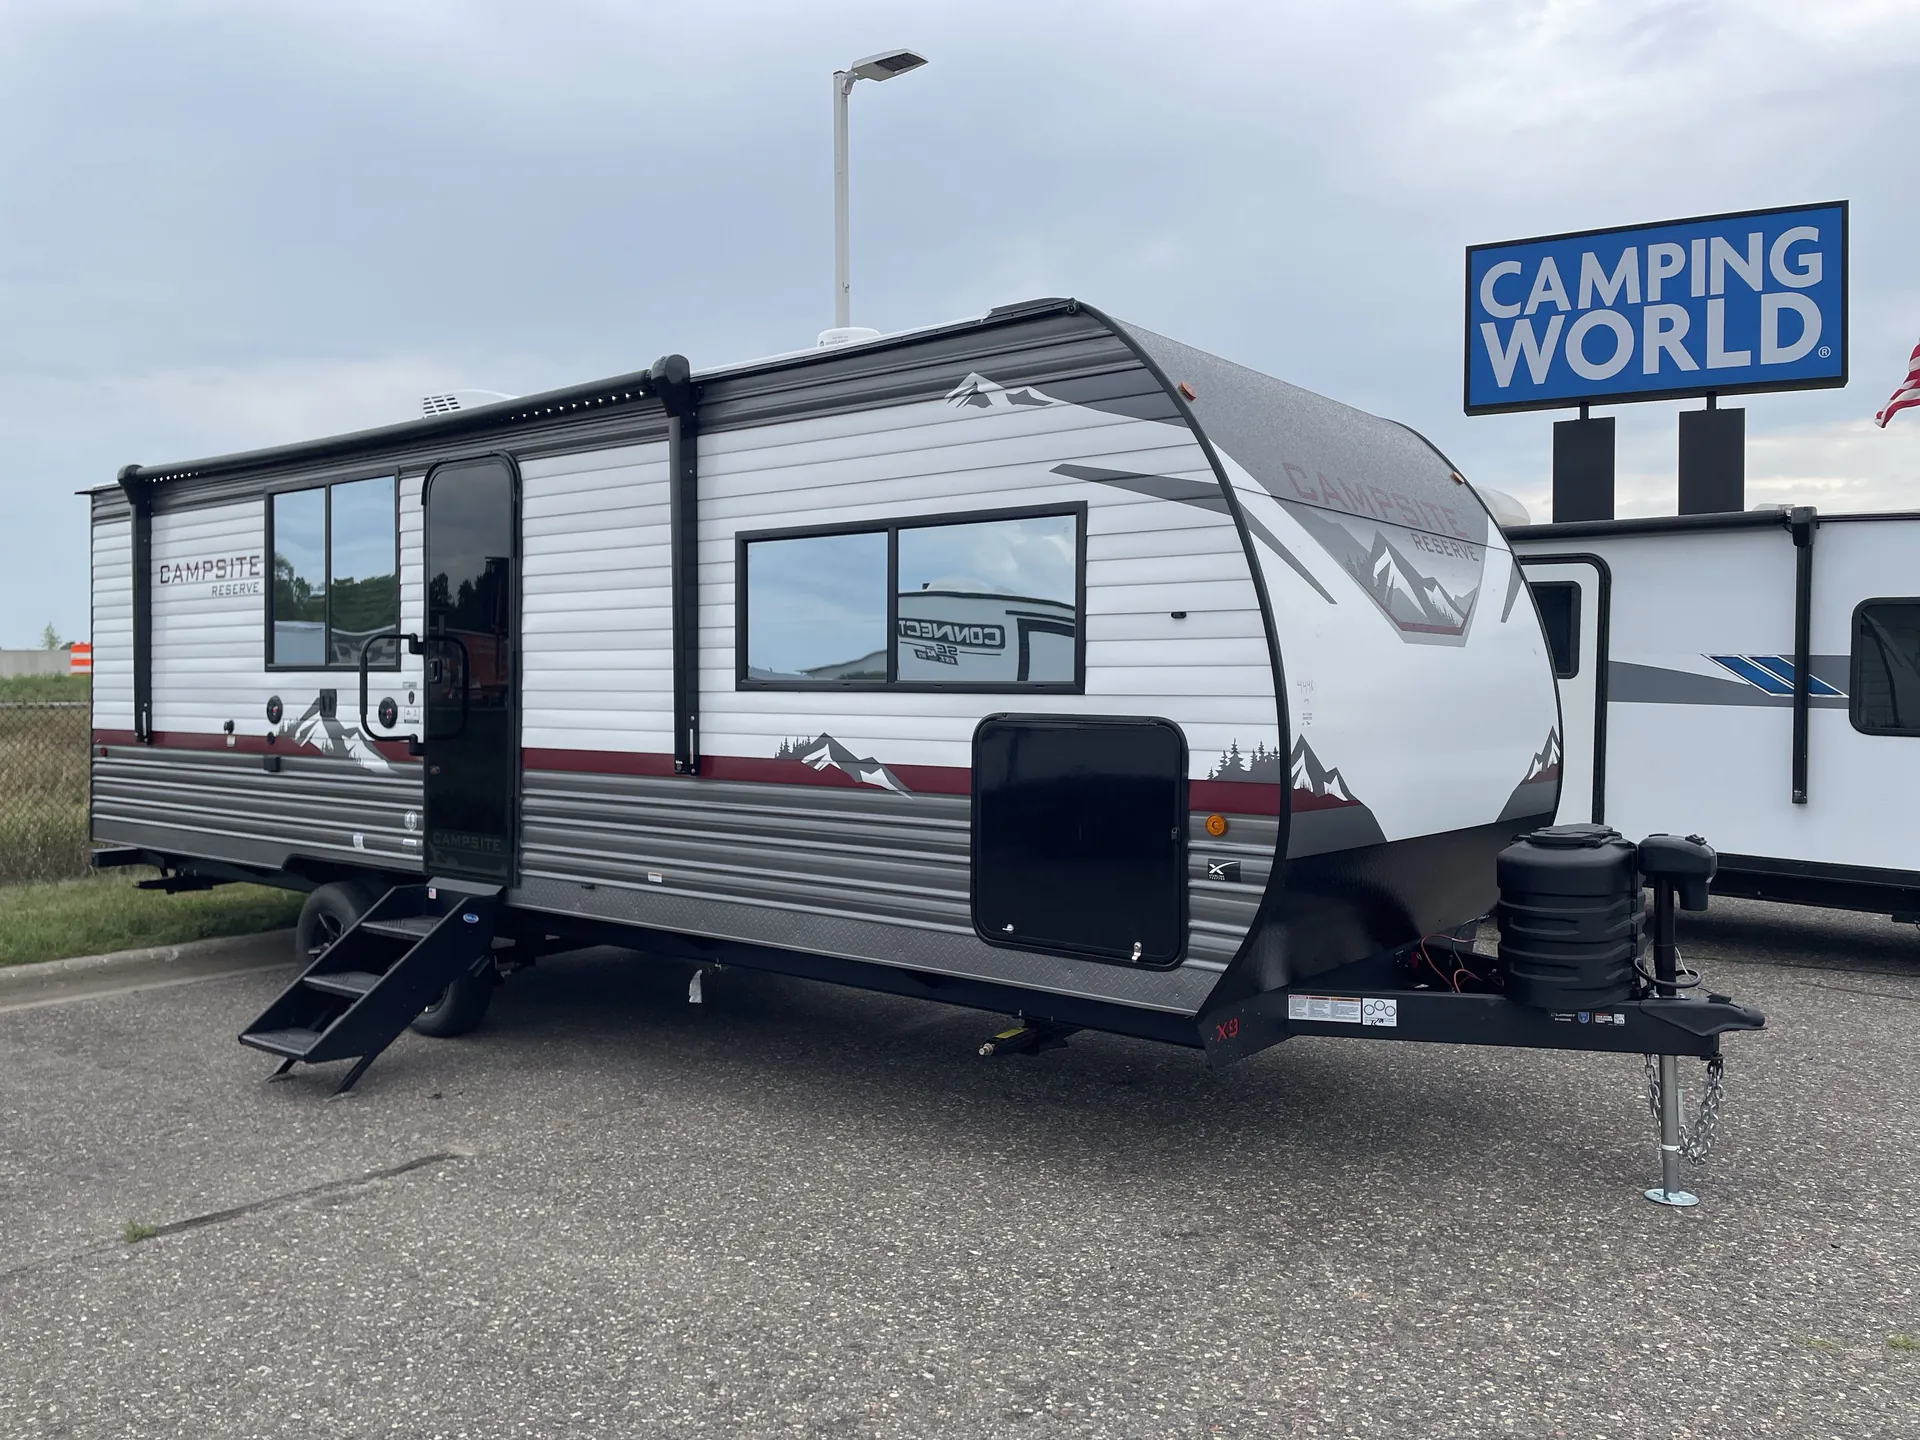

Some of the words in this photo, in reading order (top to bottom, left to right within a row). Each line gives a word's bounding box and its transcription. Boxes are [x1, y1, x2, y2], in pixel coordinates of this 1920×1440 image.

[1479, 226, 1824, 318] CAMPING
[1282, 461, 1470, 538] CAMPSITE
[1411, 533, 1480, 562] RESERVE
[160, 555, 260, 584] CAMPSITE
[211, 582, 259, 597] RESERVE
[434, 832, 501, 852] CAMPSITE
